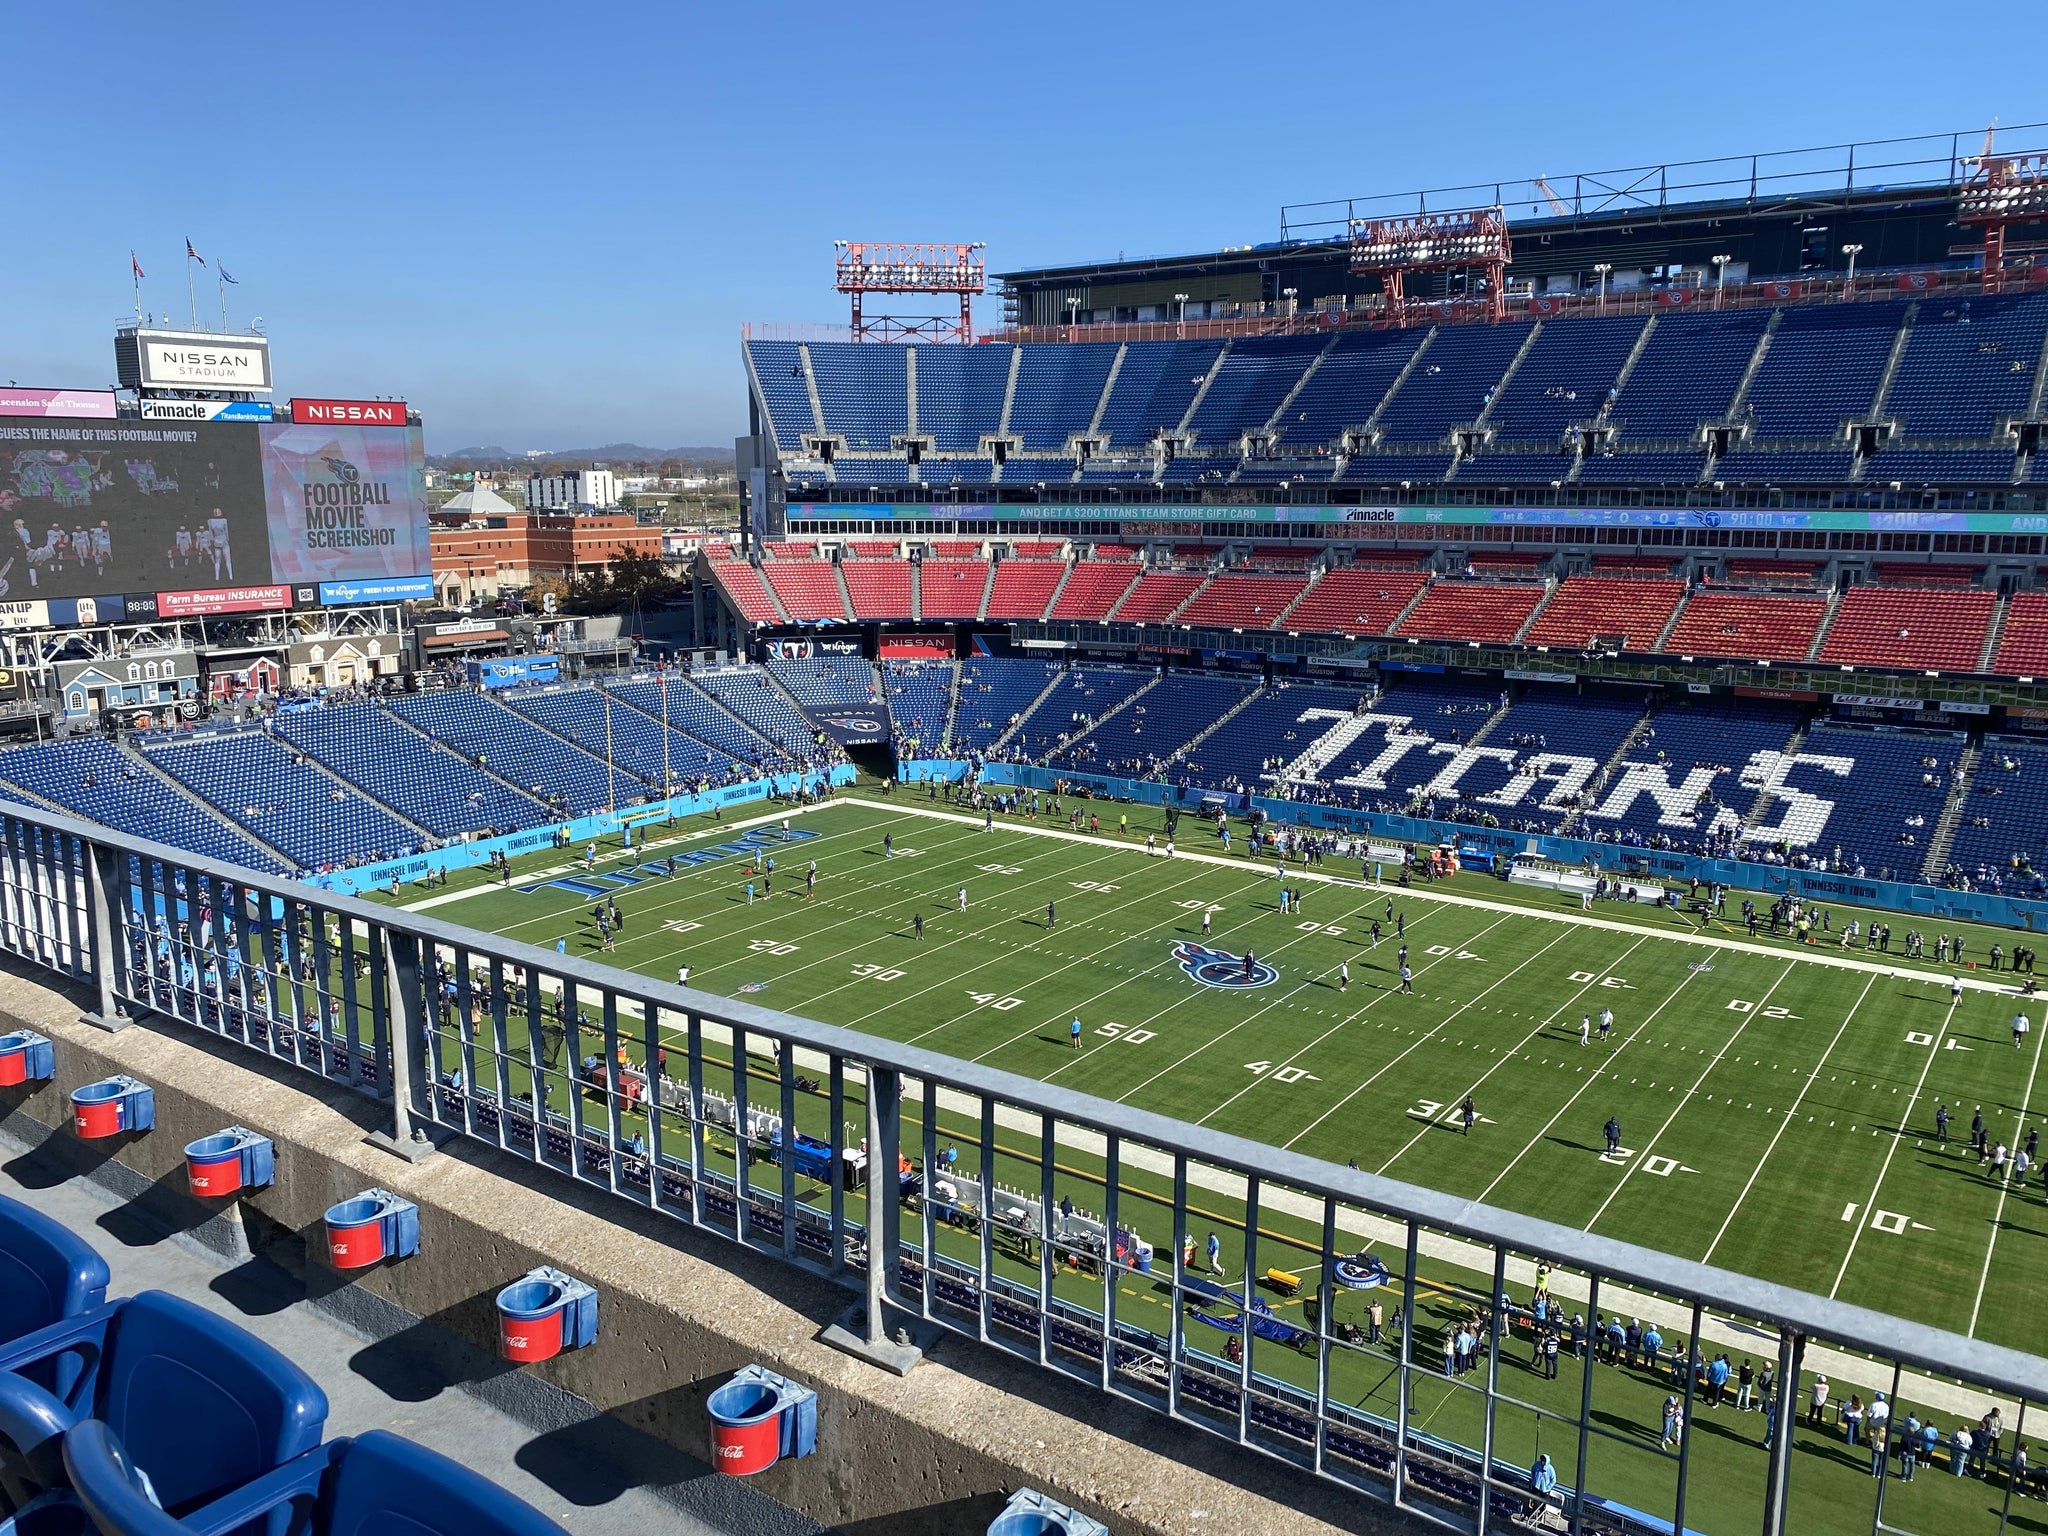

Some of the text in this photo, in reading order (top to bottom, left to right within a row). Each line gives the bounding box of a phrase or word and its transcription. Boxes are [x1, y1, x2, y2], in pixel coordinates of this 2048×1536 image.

[163, 352, 248, 367] NISSAN
[179, 367, 237, 377] STADIUM
[42, 399, 64, 407] Saint
[65, 400, 100, 409] Thomas
[144, 402, 206, 418] Pinnacle
[309, 406, 392, 419] NISSAN
[0, 427, 197, 443] GUESS THE NAME OF THIS FOOTBALL MOVIE?
[304, 483, 390, 505] FOOTBALL
[305, 506, 365, 529] MOVIE
[1020, 508, 1257, 519] AND GET A $200 TITANS TEAM STORE GIFT CARD
[1346, 508, 1394, 521] Pinnacle
[307, 528, 396, 548] SCREENSHOT
[166, 588, 283, 604] Farm Bureau INSURANCE
[17, 602, 32, 613] UP
[832, 640, 857, 655] Kroger
[889, 639, 945, 647] NISSAN
[1760, 690, 1791, 698] NISSAN
[1260, 707, 1855, 848] TITANS
[508, 834, 539, 850] TENNESSEE
[512, 823, 822, 901] TITANS
[370, 859, 428, 882] TENNESSEE TOUGH
[1803, 878, 1877, 899] TENNESSEE TOUGH
[852, 963, 907, 981] 30
[973, 992, 1025, 1010] 40
[1094, 1021, 1158, 1044] 50
[1244, 1060, 1308, 1084] 40
[1841, 1202, 1911, 1235] 10
